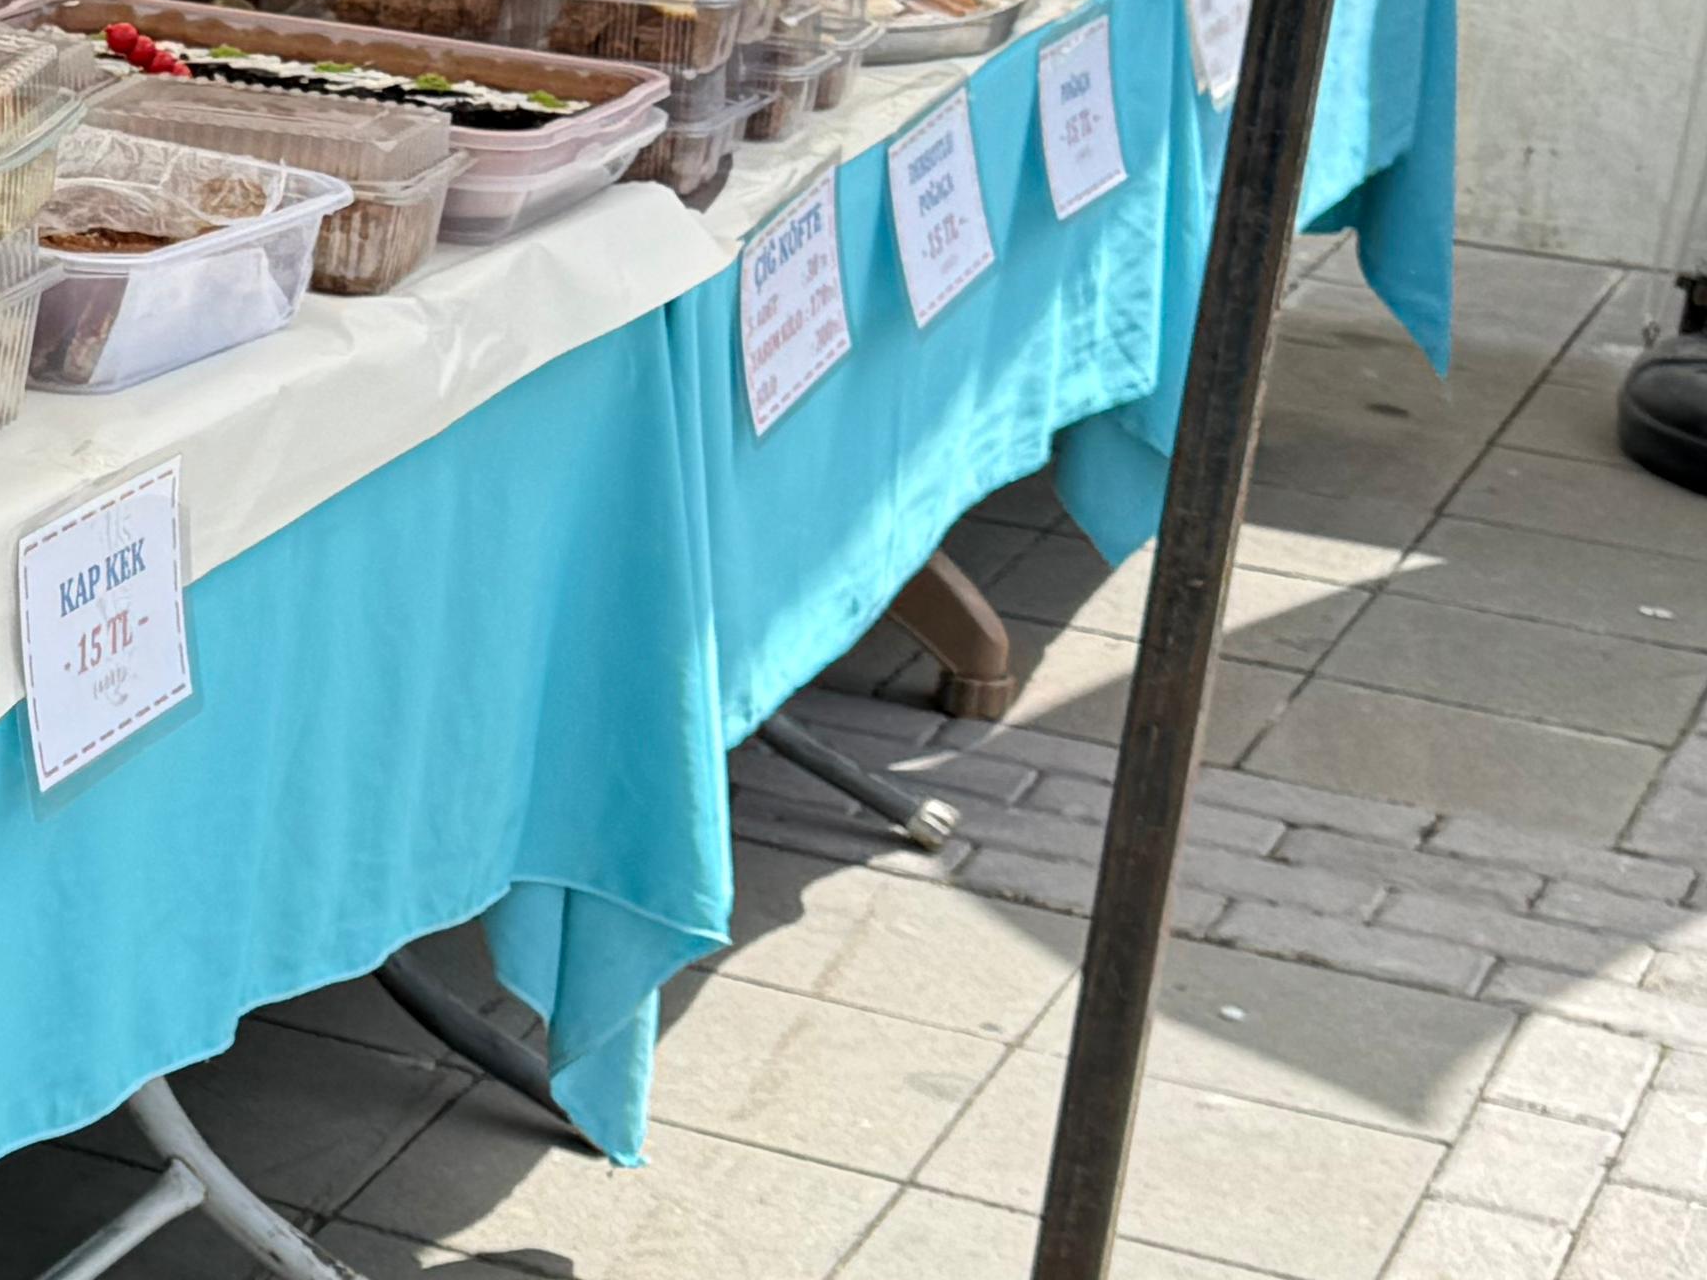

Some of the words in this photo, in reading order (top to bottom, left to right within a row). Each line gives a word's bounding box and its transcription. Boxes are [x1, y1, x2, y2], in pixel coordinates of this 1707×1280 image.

[58, 562, 101, 618] KAP
[105, 537, 147, 592] KEK
[76, 624, 103, 677] 15
[106, 608, 133, 661] TL
